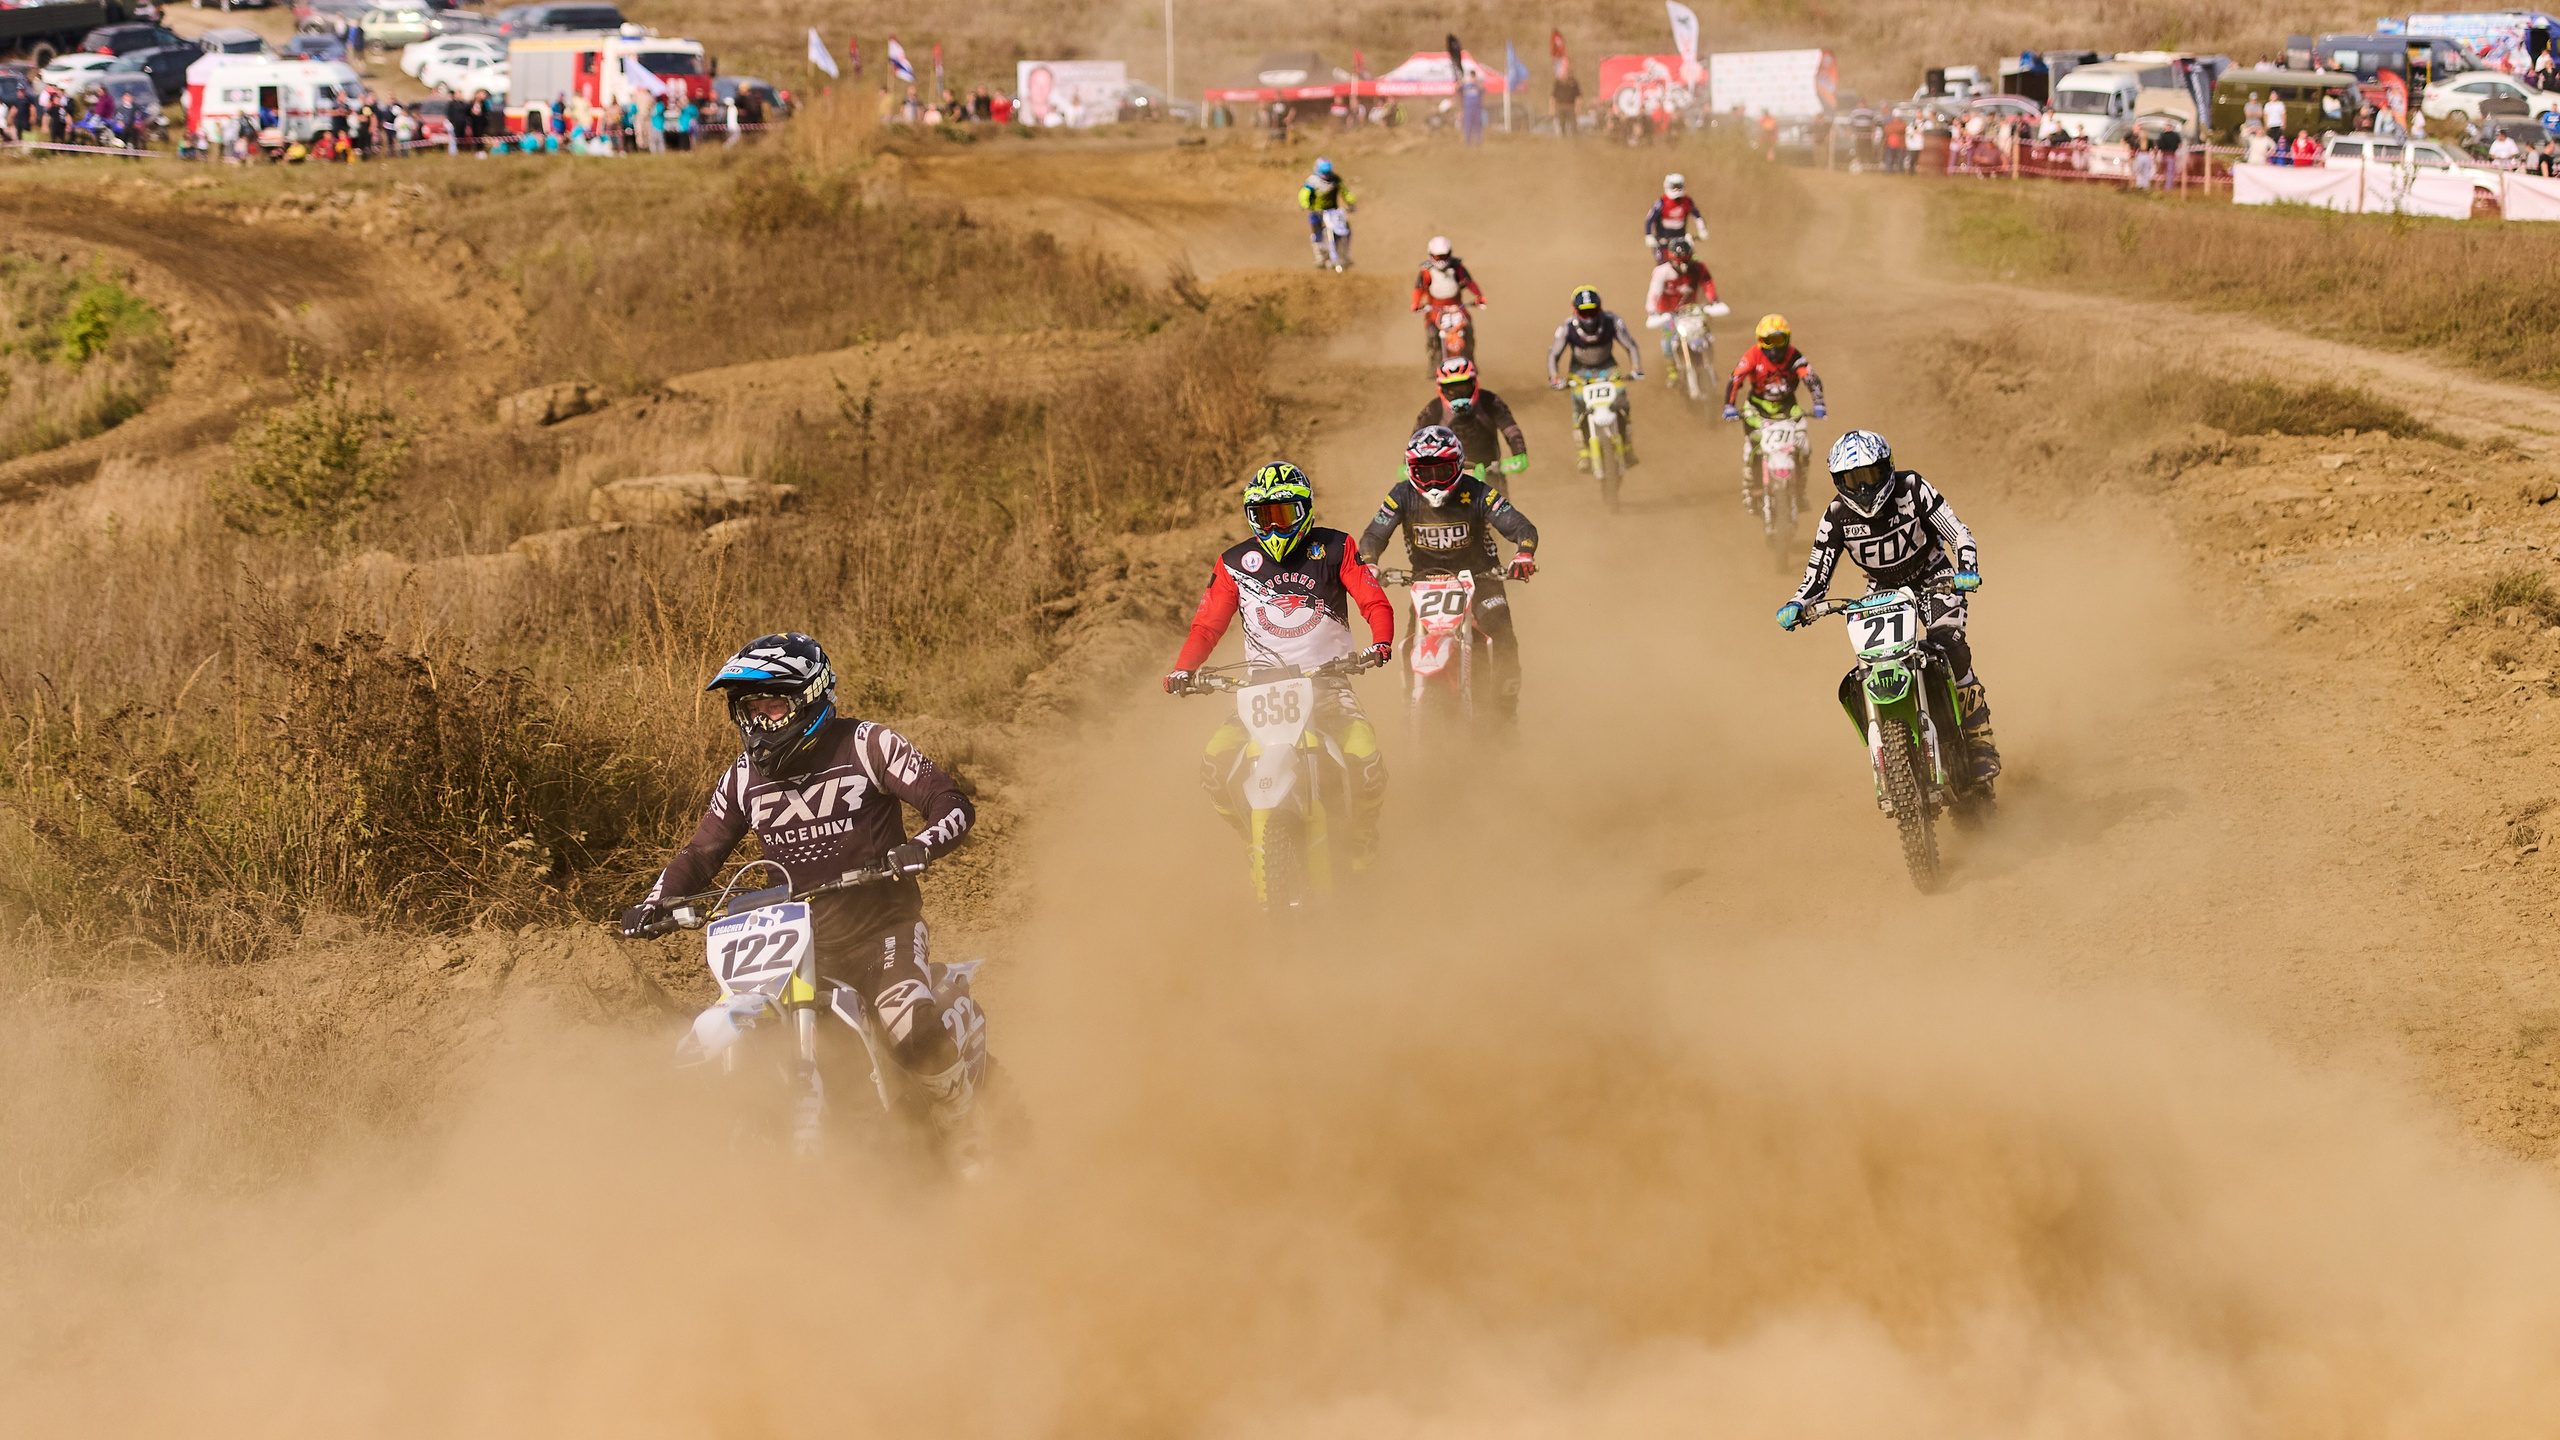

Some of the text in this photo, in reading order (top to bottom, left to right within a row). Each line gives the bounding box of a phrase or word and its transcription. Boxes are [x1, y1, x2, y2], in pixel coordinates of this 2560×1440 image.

[1415, 524, 1465, 538] MOTO
[1844, 525, 1867, 536] FOX
[1859, 520, 1919, 565] FOX
[1420, 590, 1465, 619] 20
[1864, 614, 1903, 650] 21
[1252, 690, 1300, 728] 858
[751, 774, 869, 830] FXR
[914, 807, 967, 846] FXR
[713, 923, 744, 936] LOGACHEV
[721, 929, 800, 980] 122
